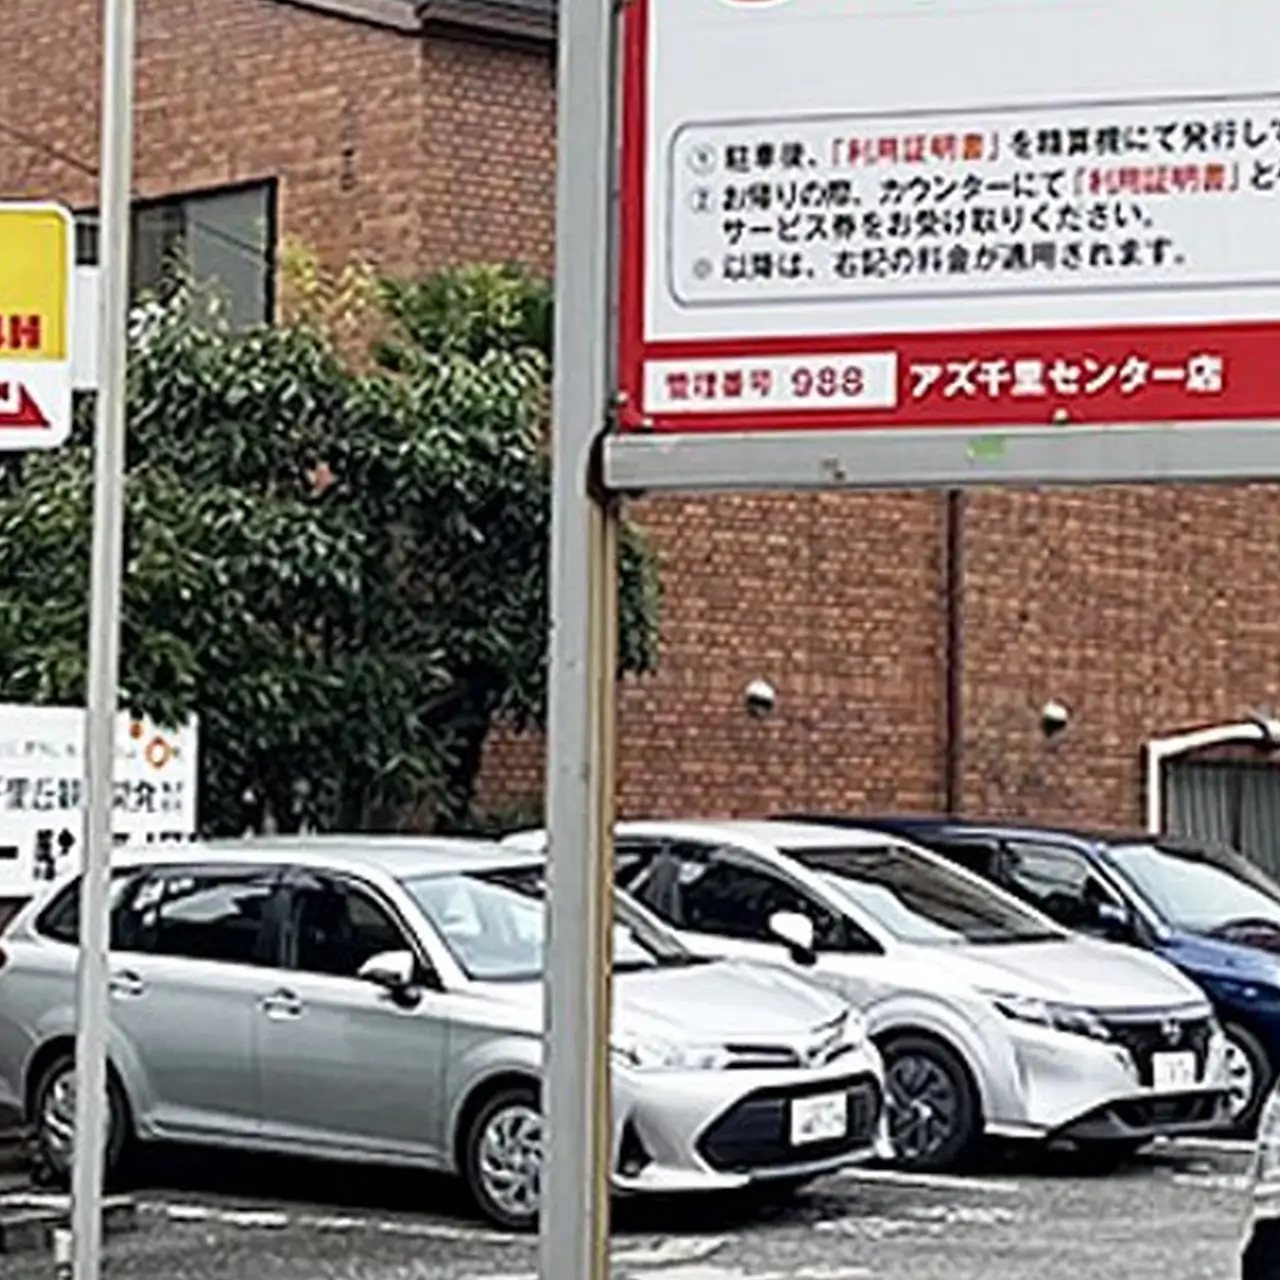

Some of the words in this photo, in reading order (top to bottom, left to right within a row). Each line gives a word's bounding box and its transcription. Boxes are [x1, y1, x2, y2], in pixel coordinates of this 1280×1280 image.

[665, 370, 773, 400] 管理番号
[790, 365, 866, 398] 988
[910, 354, 1223, 397] アズ千里センター店
